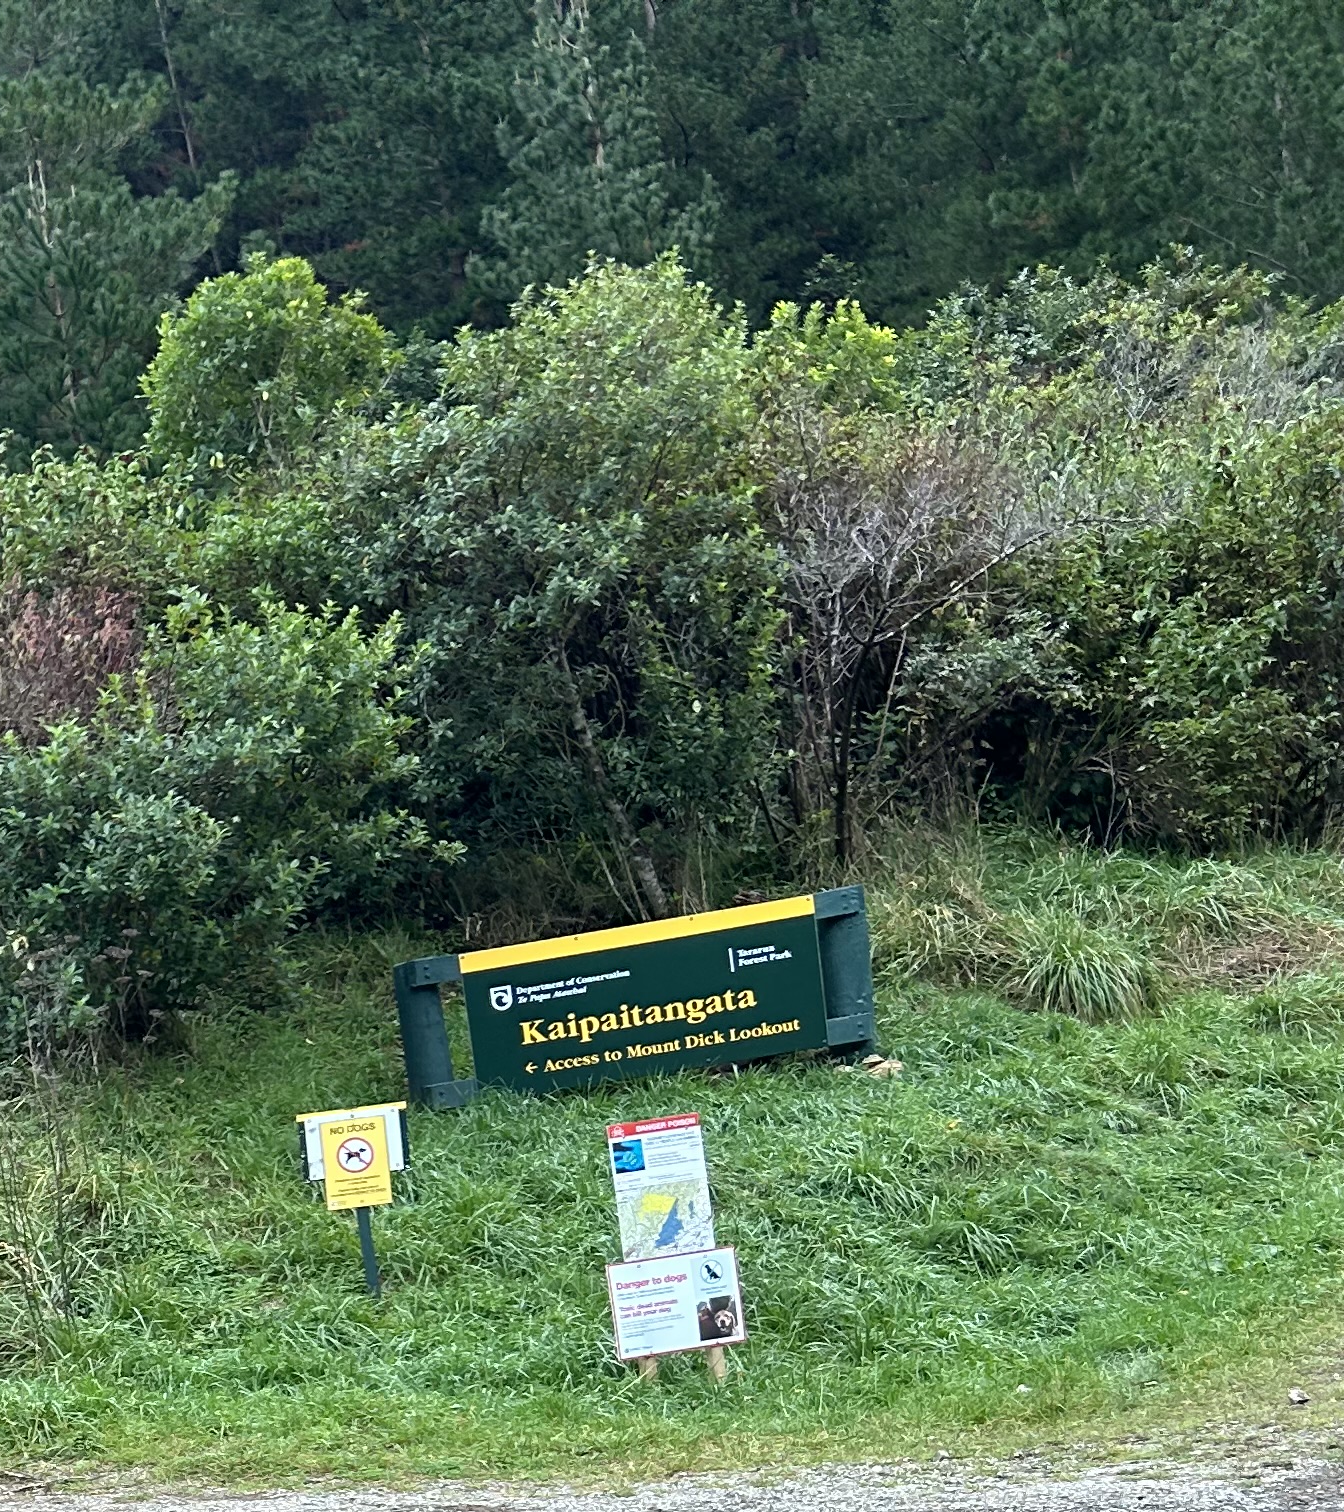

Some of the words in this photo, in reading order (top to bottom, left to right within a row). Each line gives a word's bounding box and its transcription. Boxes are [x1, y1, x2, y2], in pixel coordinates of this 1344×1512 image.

[738, 955, 768, 966] Forest
[769, 949, 792, 960] Park
[516, 981, 564, 995] Department
[565, 978, 575, 986] of
[576, 970, 630, 984] Conservation
[518, 988, 757, 1045] Kaipaitangata
[543, 1052, 600, 1073] Access
[604, 1048, 622, 1062] to
[626, 1039, 681, 1060] Mount
[685, 1031, 725, 1049] Dick
[729, 1018, 801, 1042] Lookout
[329, 1127, 345, 1135] NO
[347, 1122, 376, 1133] DOGS
[635, 1121, 666, 1132] DANGER
[667, 1117, 696, 1127] POISON
[616, 1280, 650, 1290] Danger
[652, 1277, 662, 1285] to
[664, 1273, 687, 1283] dogs
